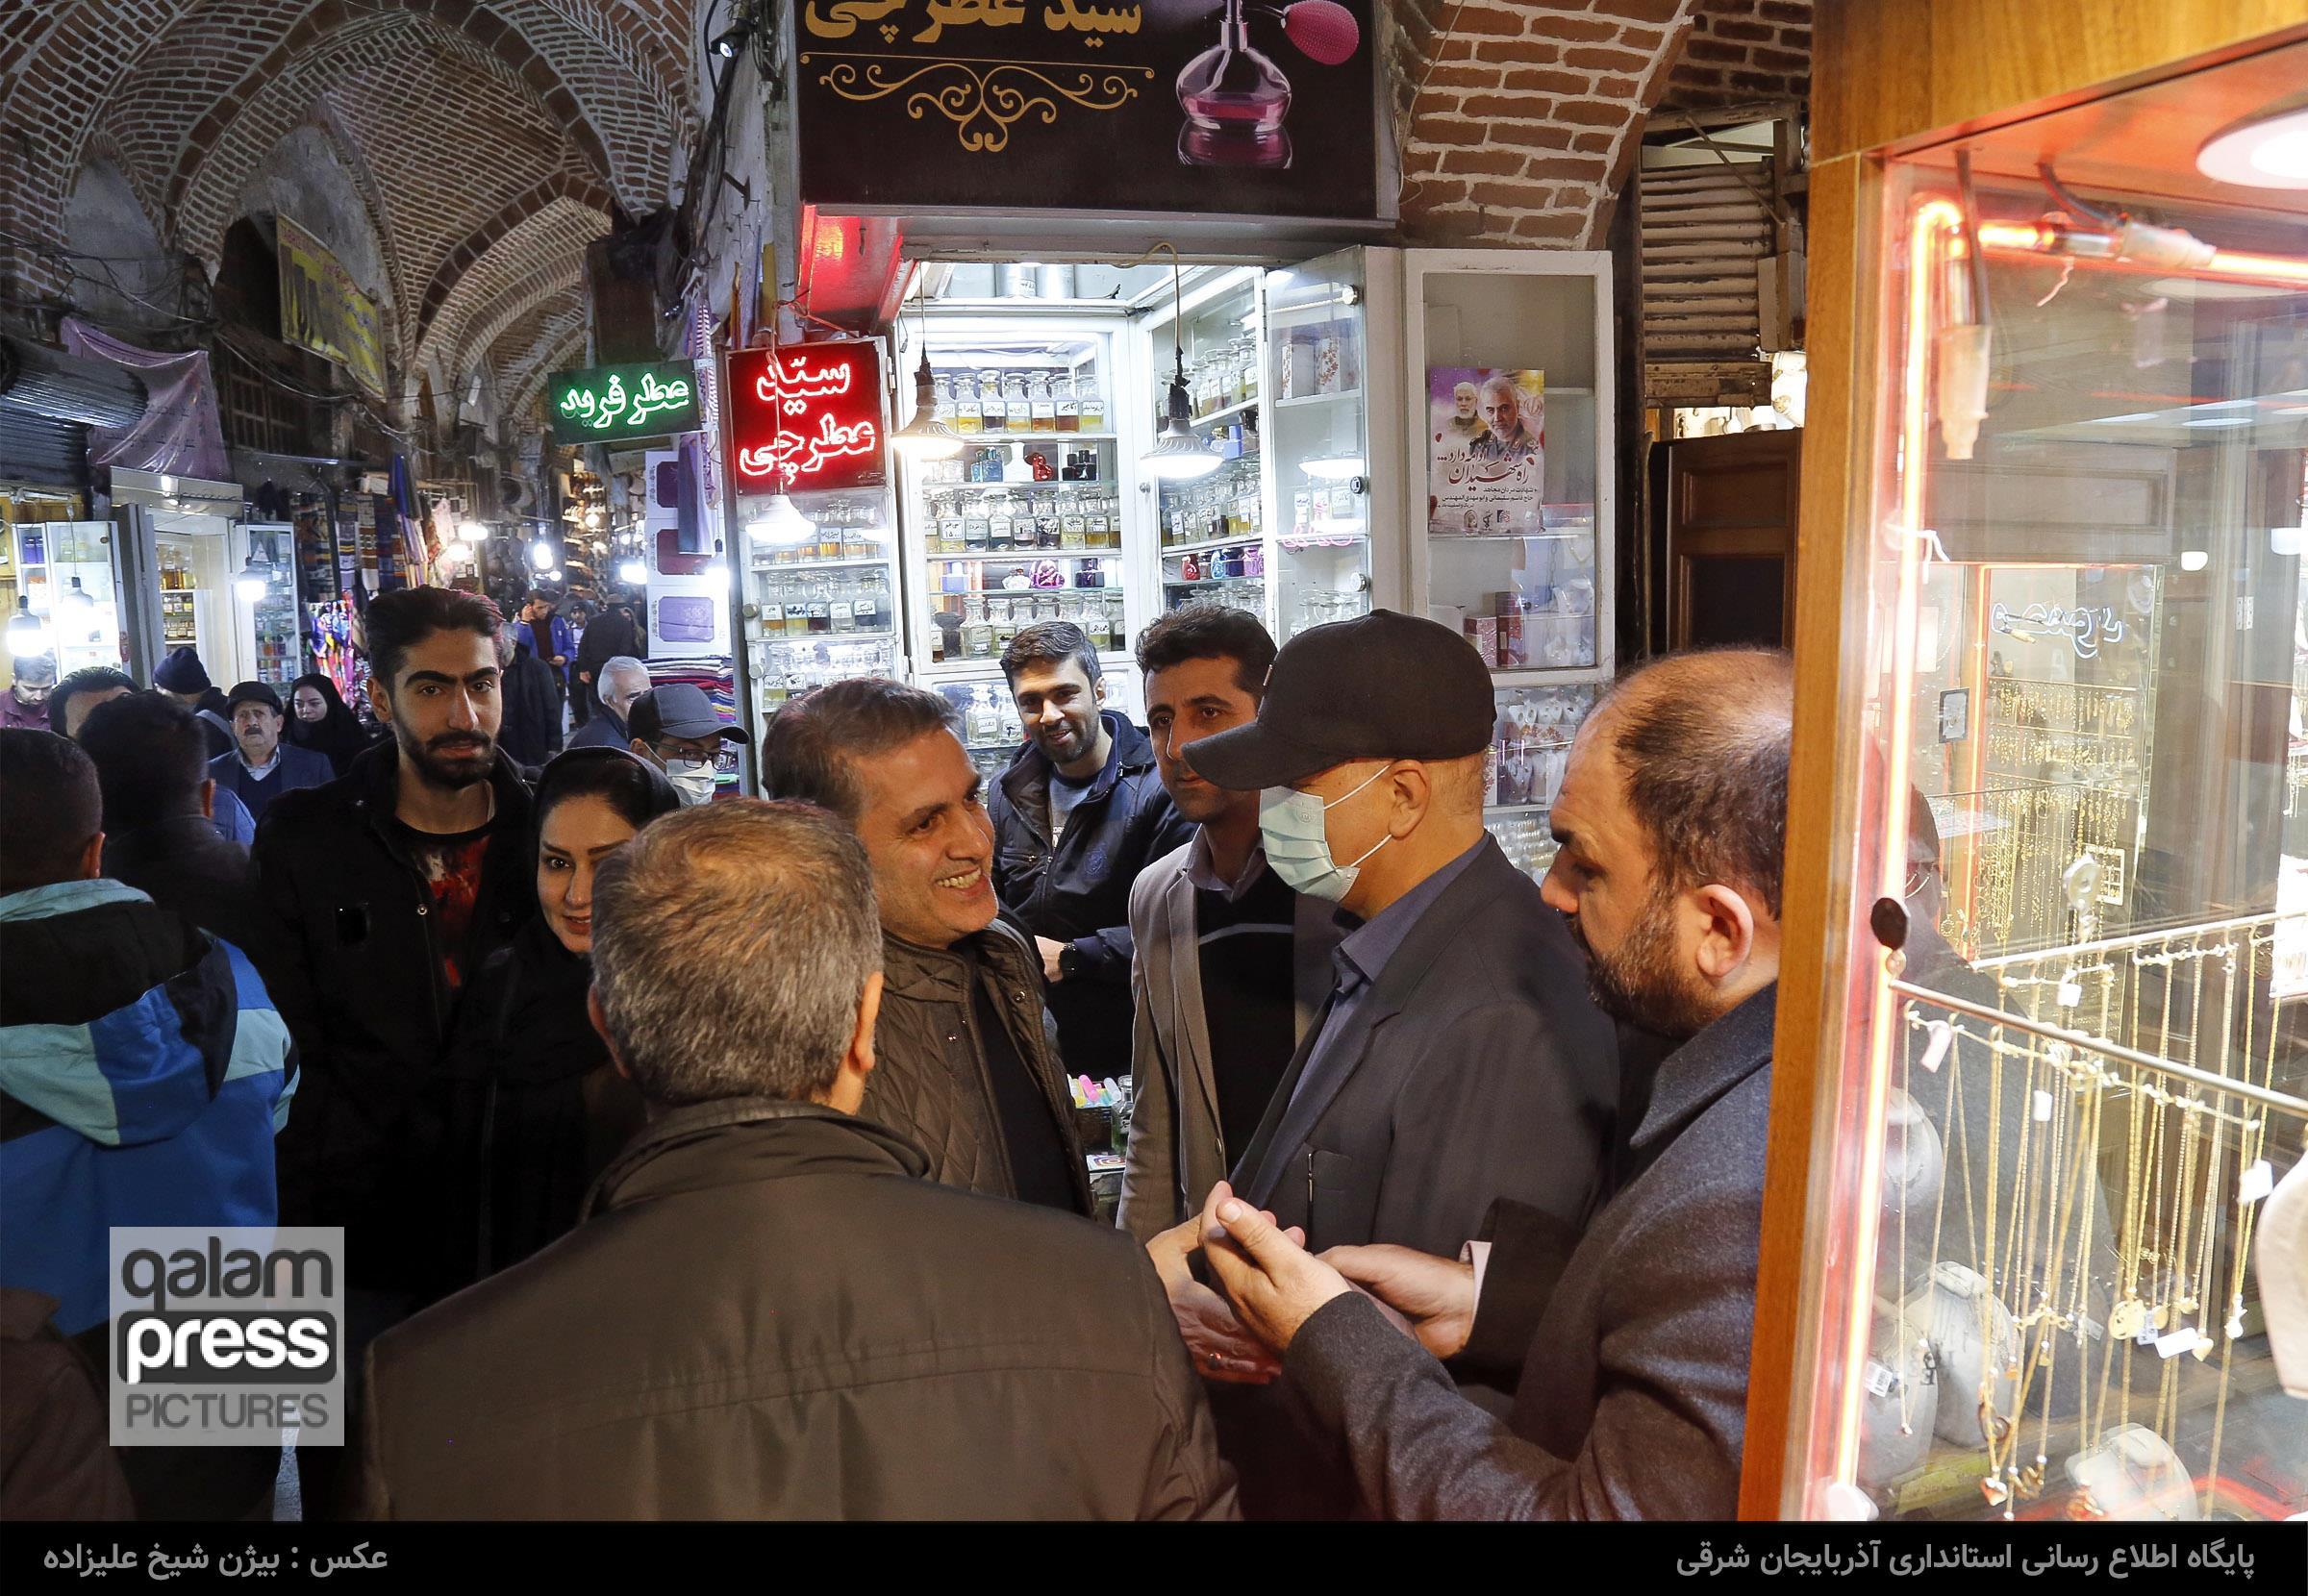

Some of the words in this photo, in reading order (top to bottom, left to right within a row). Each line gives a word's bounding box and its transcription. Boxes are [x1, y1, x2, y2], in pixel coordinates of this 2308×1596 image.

[626, 372, 690, 425] عطر
[1448, 450, 1522, 491] شهیدان
[1516, 464, 1529, 485] راه
